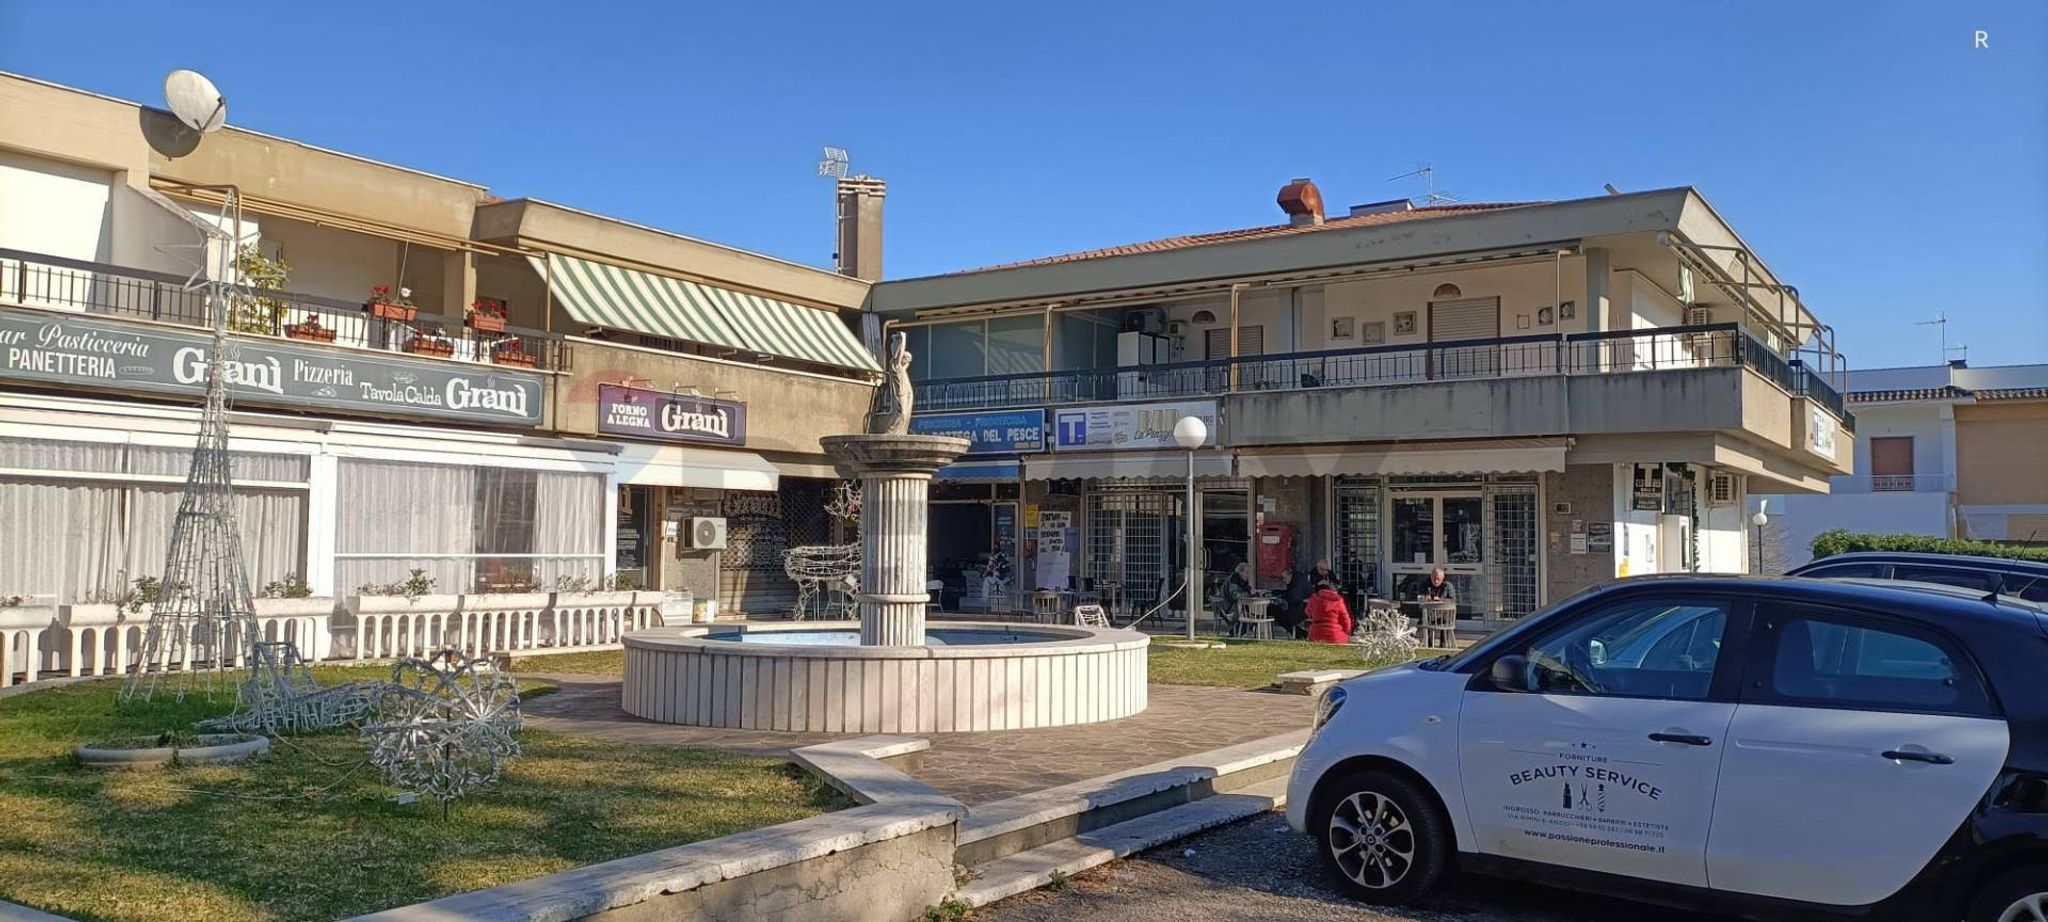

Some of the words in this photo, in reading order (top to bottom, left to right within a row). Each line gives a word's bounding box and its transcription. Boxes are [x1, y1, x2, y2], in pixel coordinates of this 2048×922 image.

[0, 332, 27, 347] ar
[36, 323, 151, 359] Pasticceria
[9, 347, 117, 380] PANETTERIA
[293, 359, 354, 387] Pizzeria
[445, 376, 528, 418] Granì
[611, 403, 647, 416] FORNO
[661, 402, 729, 439] Granì
[983, 428, 1002, 443] DEL
[1006, 426, 1040, 443] PESCE
[1559, 752, 1608, 763] FORNITURE
[1510, 765, 1579, 785] BEAUTY
[1585, 767, 1662, 800] SERVICE
[1523, 829, 1665, 853] www.passioneprofessionale.it
